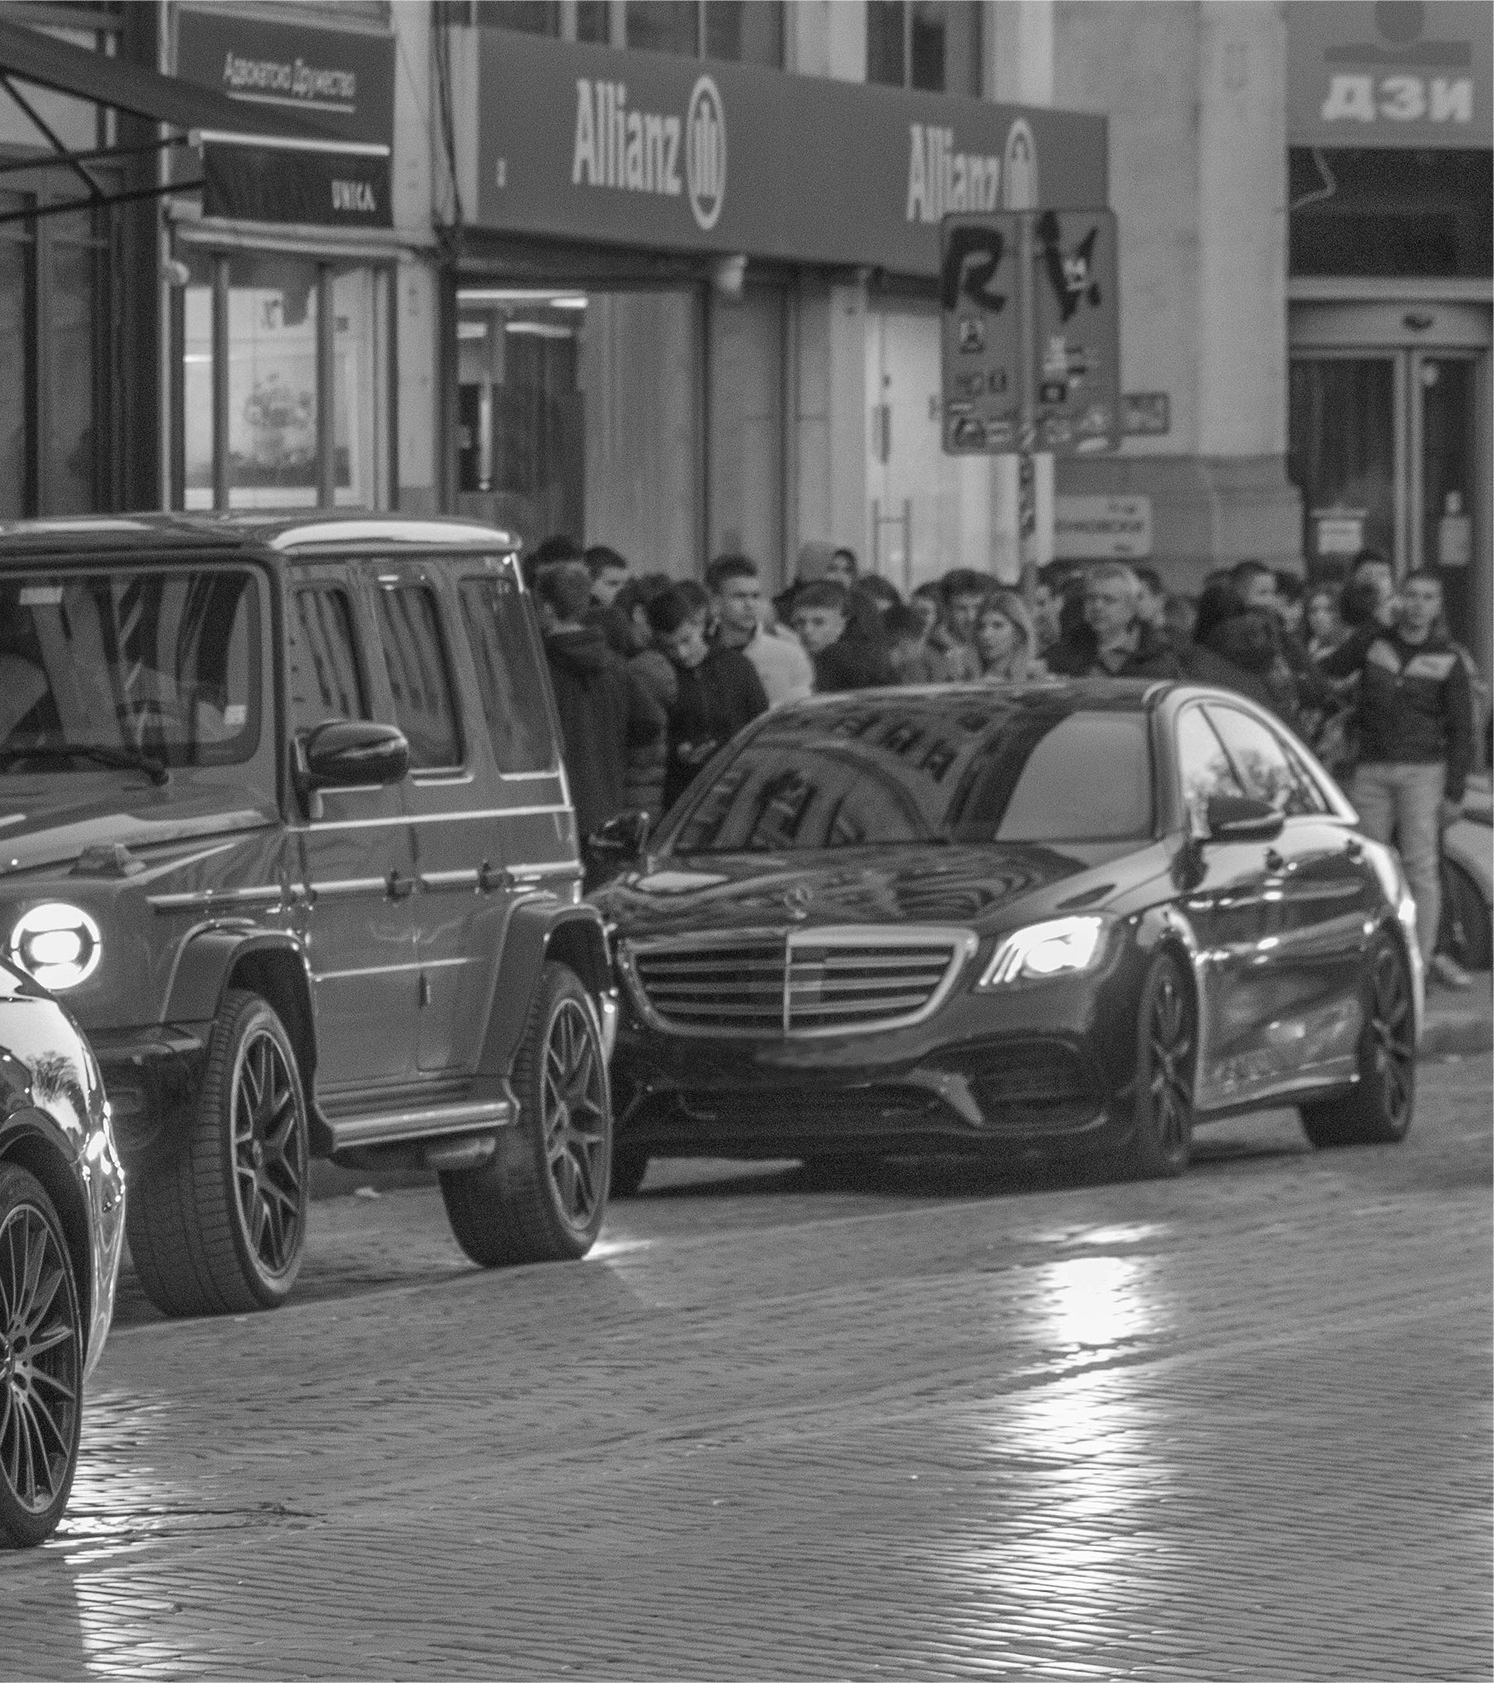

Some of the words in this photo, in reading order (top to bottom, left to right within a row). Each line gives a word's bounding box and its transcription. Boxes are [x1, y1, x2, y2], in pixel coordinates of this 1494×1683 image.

[1321, 75, 1474, 122] ДЗИ
[571, 78, 682, 196] Allianz
[907, 122, 1001, 225] Allianz
[331, 181, 376, 212] UNICA
